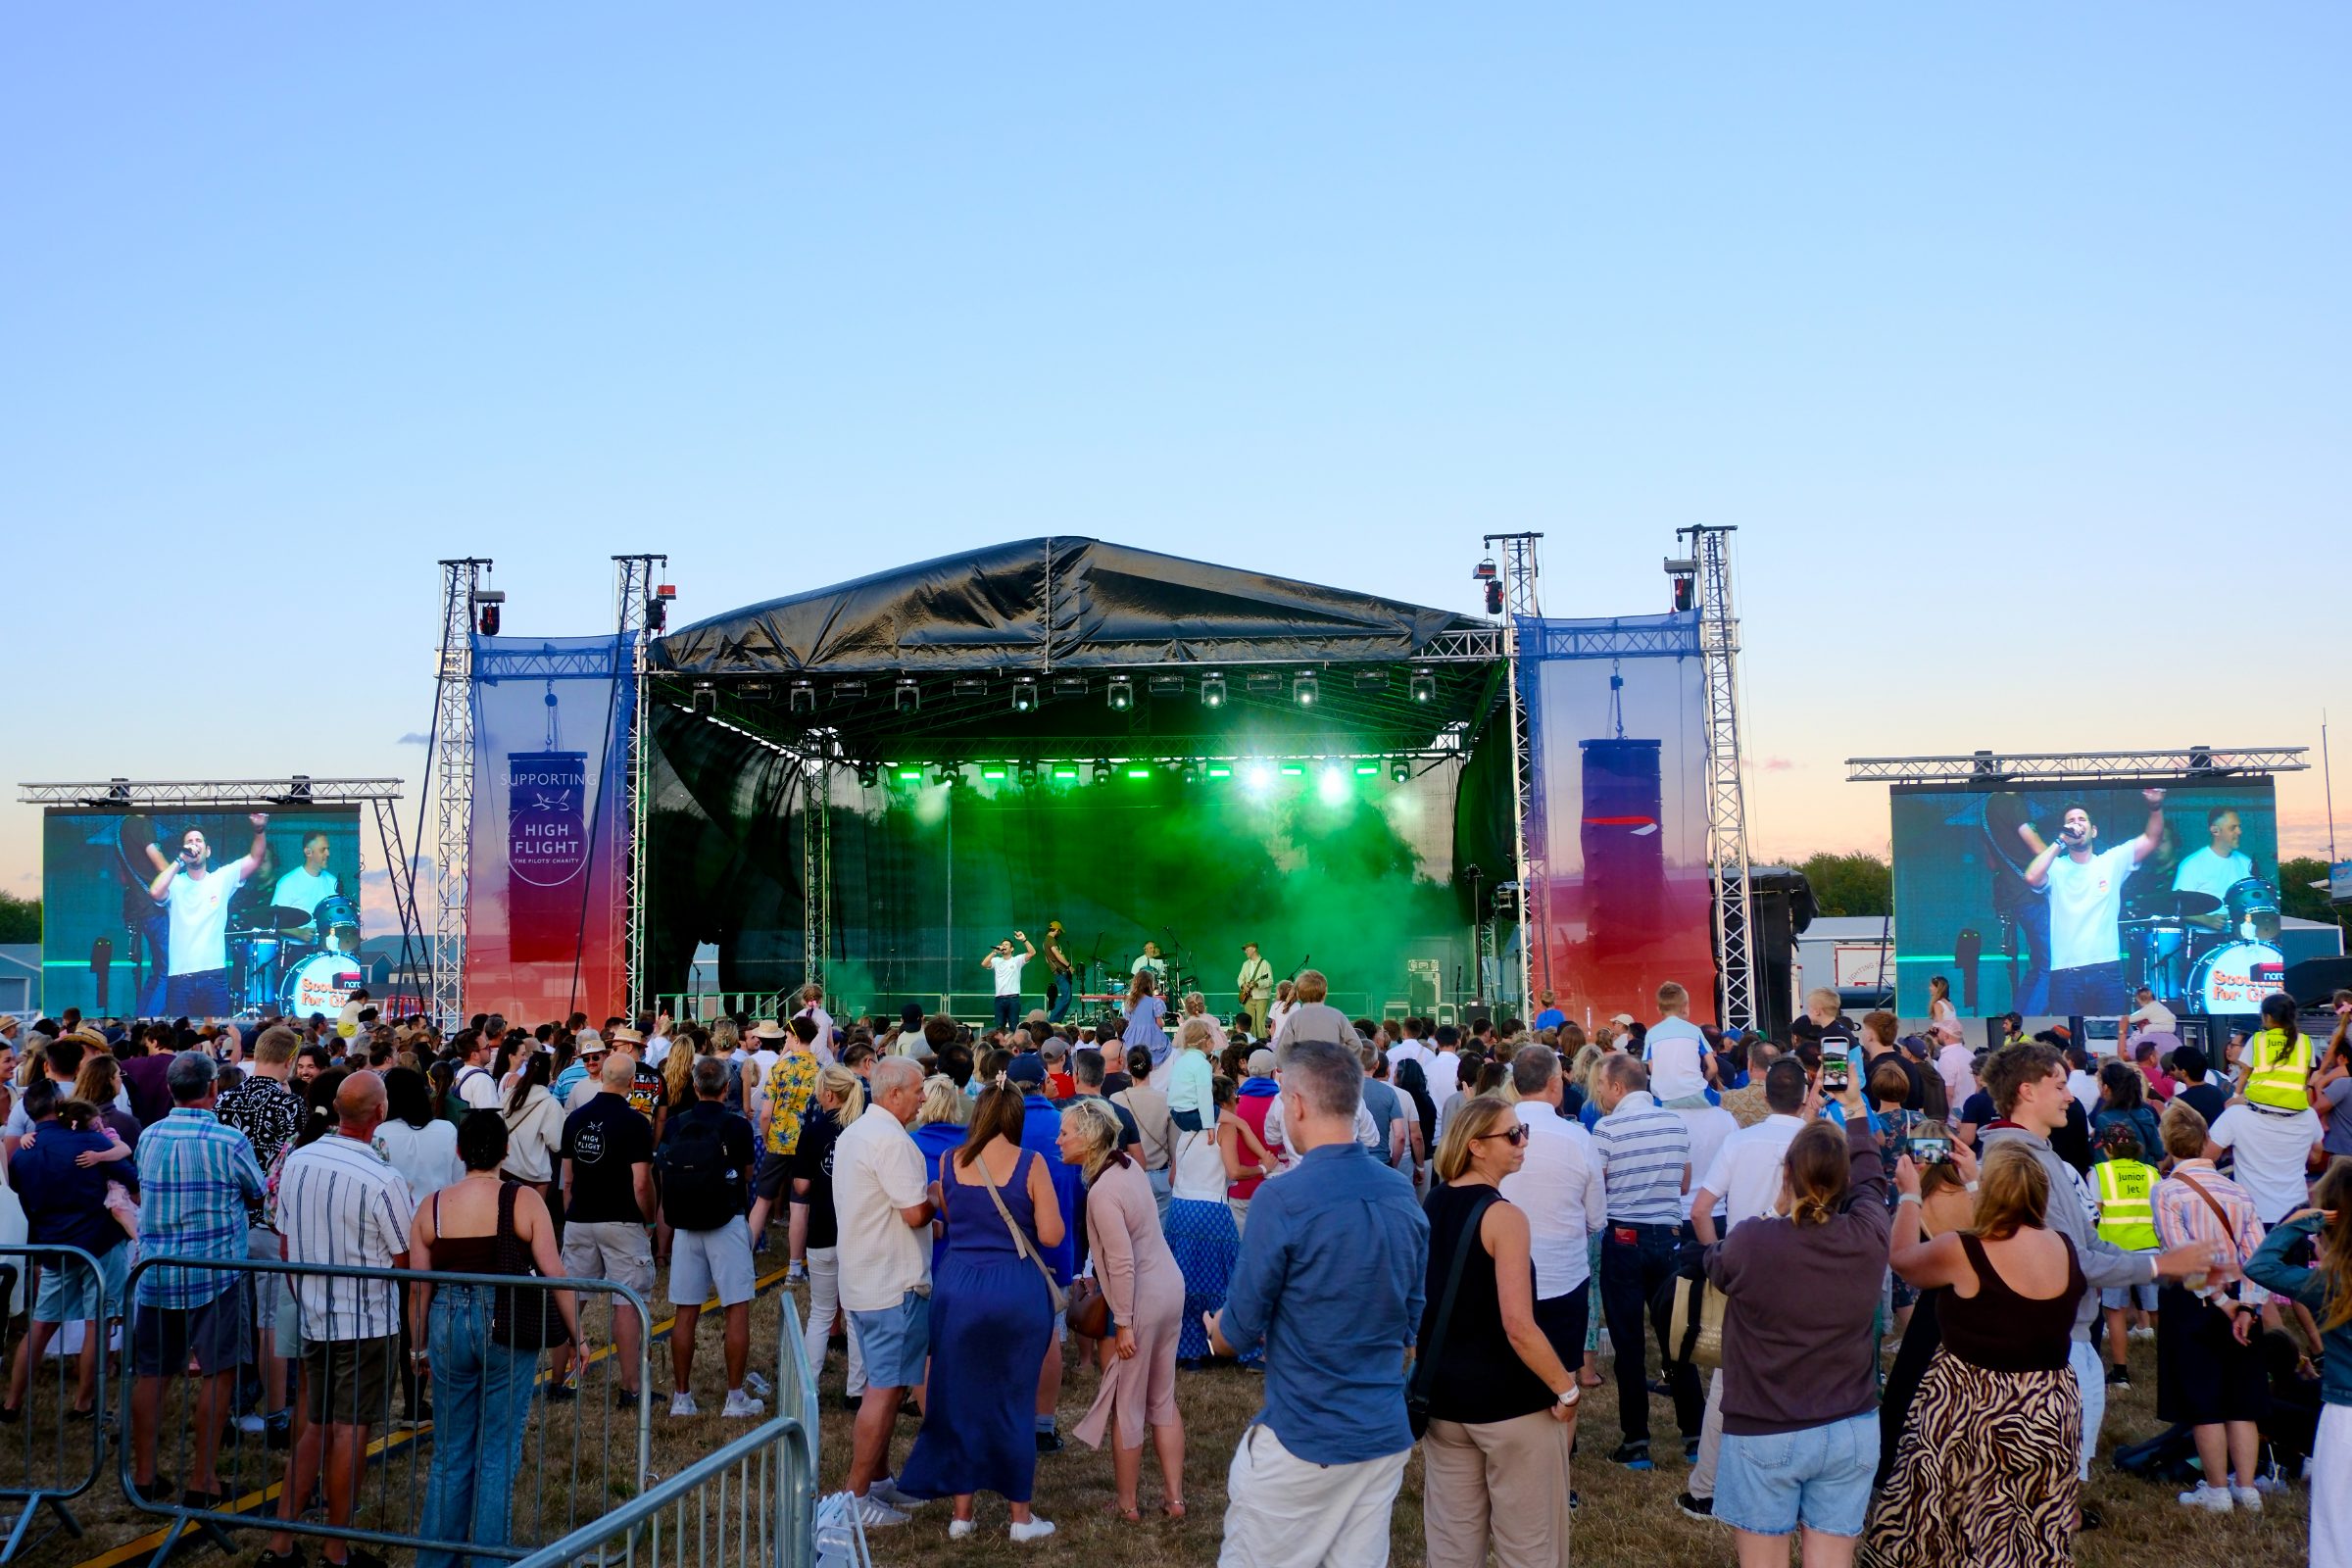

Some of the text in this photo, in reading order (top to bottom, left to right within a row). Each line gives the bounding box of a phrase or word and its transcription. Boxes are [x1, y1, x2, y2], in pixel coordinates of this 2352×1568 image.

[501, 773, 597, 786] SUPPORTING
[525, 824, 568, 837] HIGH
[514, 841, 579, 854] FLIGHT
[2119, 1172, 2145, 1182] Junior
[2128, 1185, 2140, 1194] Jet
